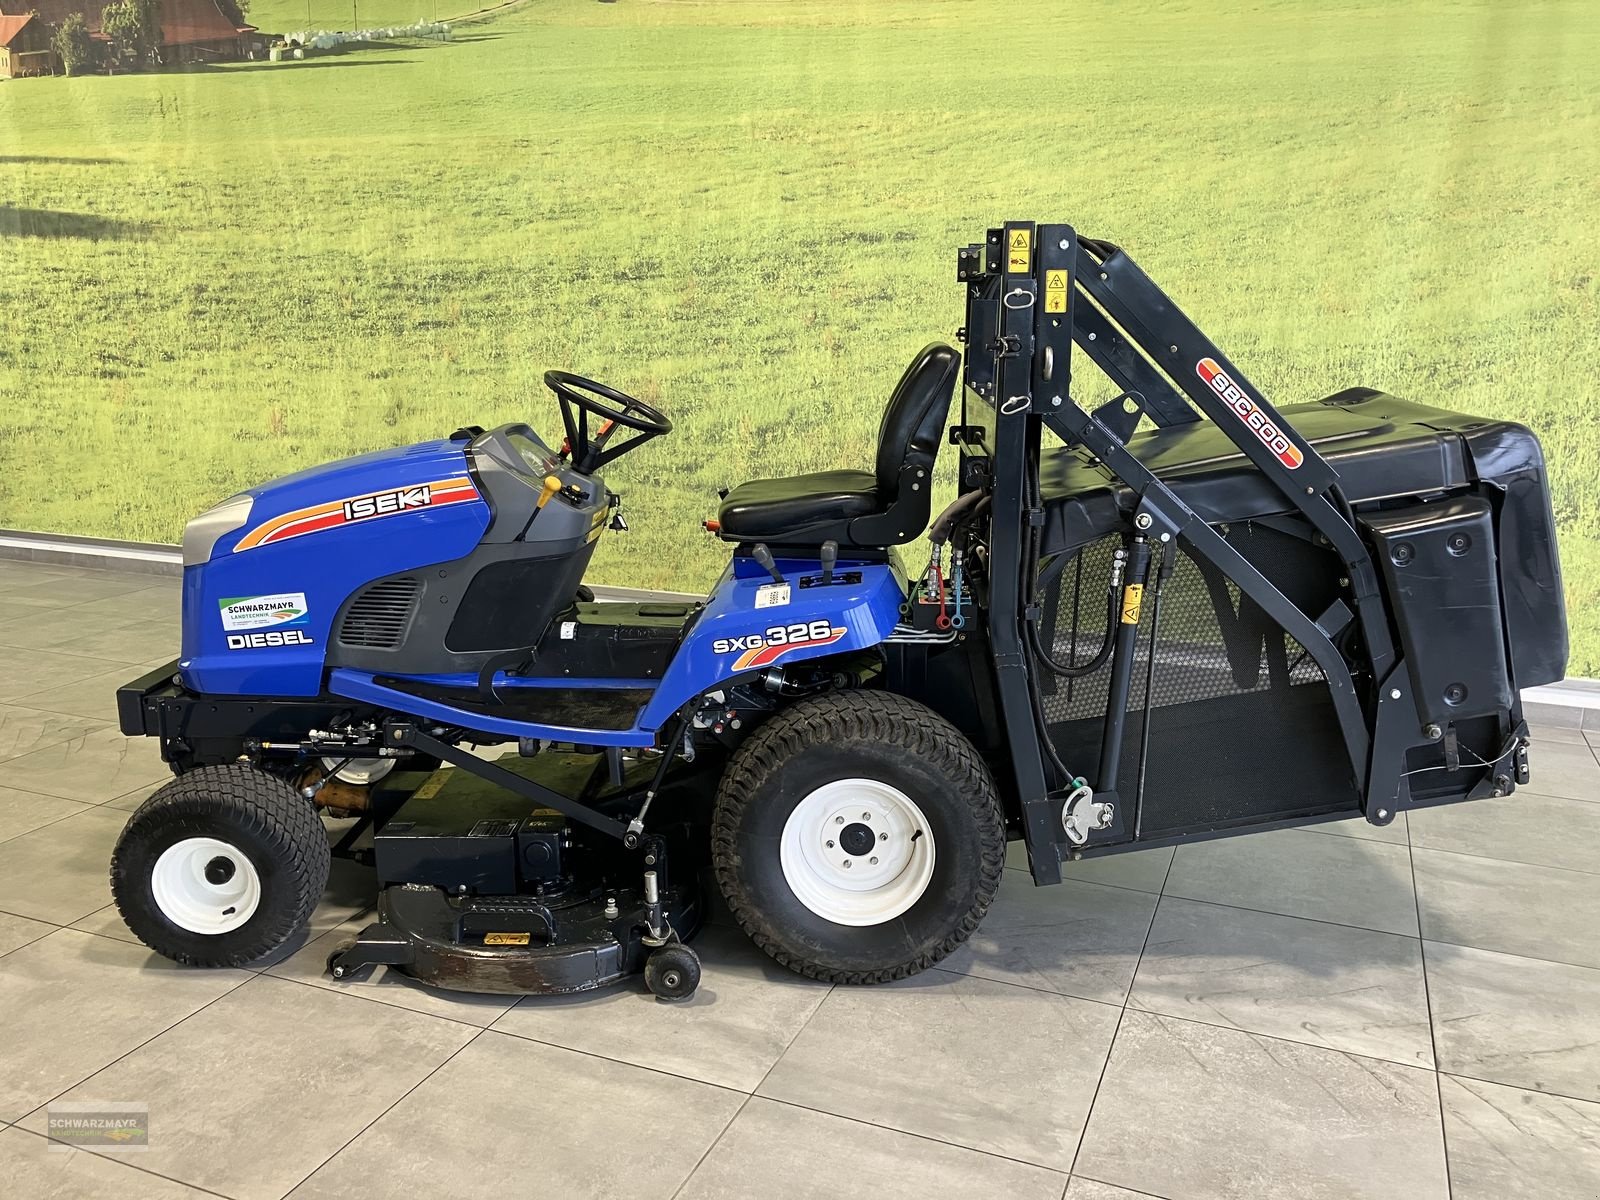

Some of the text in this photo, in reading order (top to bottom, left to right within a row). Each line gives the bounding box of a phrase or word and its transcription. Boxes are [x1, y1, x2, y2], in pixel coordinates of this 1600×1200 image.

[1210, 372, 1290, 455] SBC 600
[343, 485, 431, 520] ISEKI
[228, 602, 294, 613] SCHWARZMAYR
[226, 629, 314, 650] DIESEL
[712, 619, 832, 654] SXG 326
